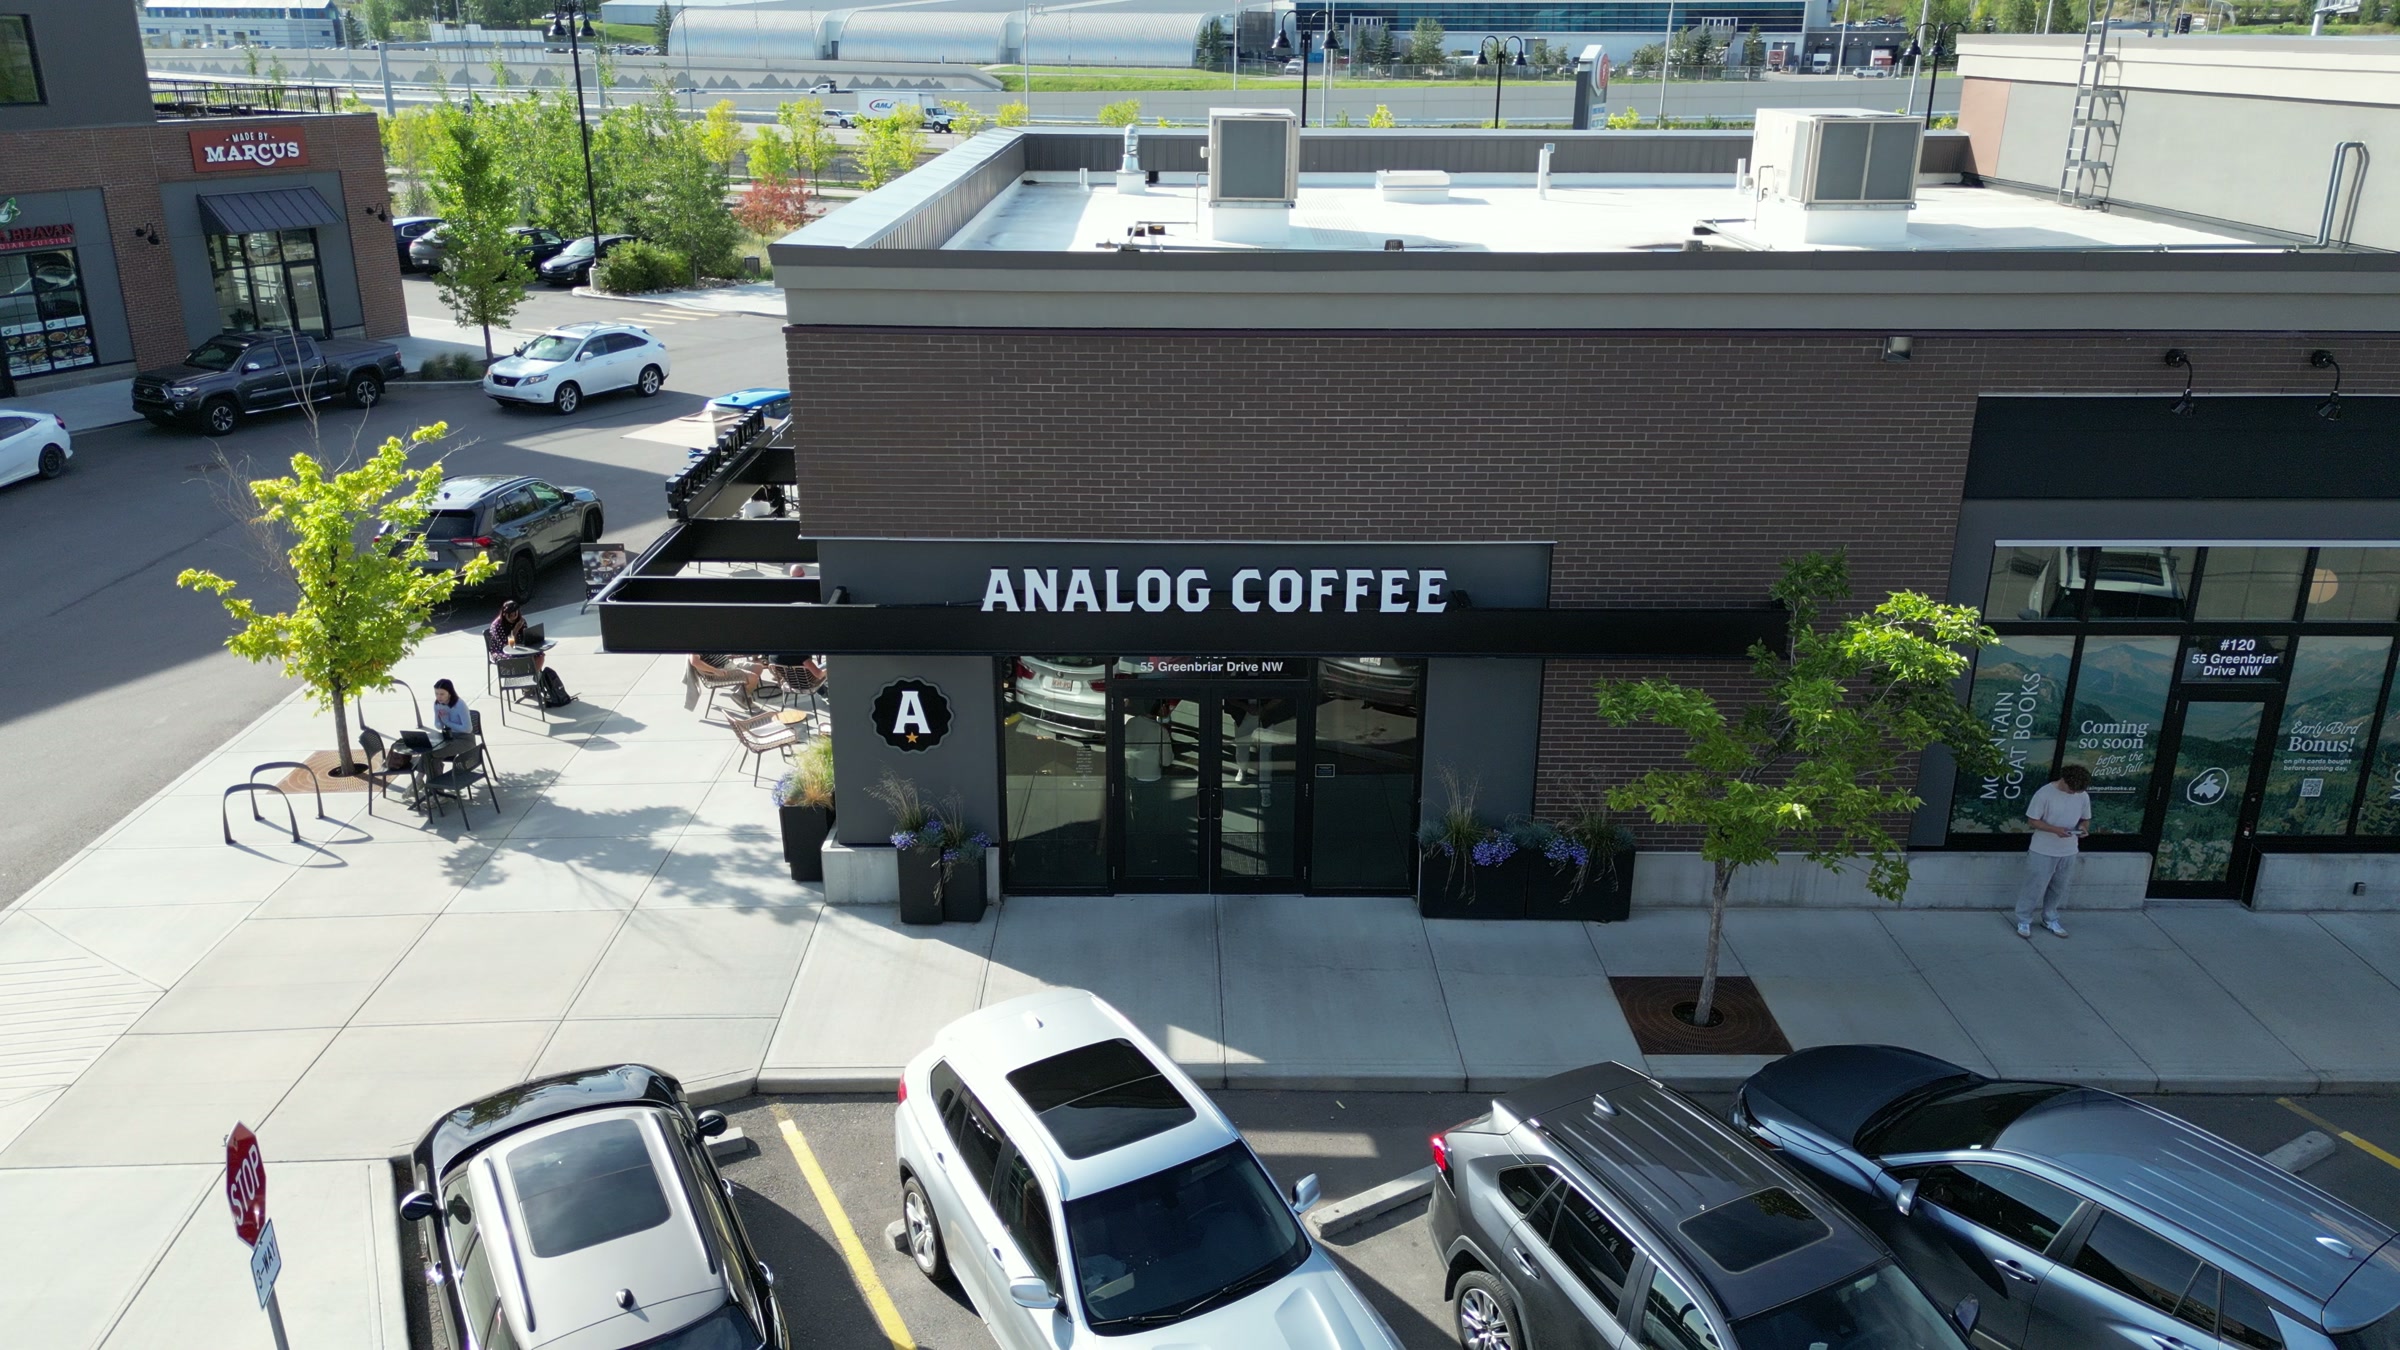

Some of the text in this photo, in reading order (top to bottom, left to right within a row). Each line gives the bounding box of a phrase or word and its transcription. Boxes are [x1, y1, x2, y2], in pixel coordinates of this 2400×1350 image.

[231, 131, 268, 142] MADE BY
[204, 141, 300, 166] MARCUS
[12, 224, 75, 241] BHAVAN
[30, 237, 72, 247] CUISINE
[981, 568, 1448, 613] ANALOG COFFEE
[2220, 638, 2256, 651] #120
[1140, 661, 1284, 672] 55 Greenbriar Drive NW
[2191, 653, 2279, 664] 55 Greenbriar
[2203, 665, 2262, 676] Drive NW
[892, 690, 932, 734] A
[2003, 672, 2041, 800] GOAT BOOKS
[2080, 719, 2150, 738] Coming
[2291, 720, 2364, 738] Early Bird
[2078, 738, 2145, 749] so soon
[2287, 736, 2355, 753] Bonus!
[2095, 751, 2144, 768] before the
[2091, 762, 2144, 777] leaves fall
[230, 1144, 260, 1227] STOP
[255, 1236, 277, 1290] 3-WAY
